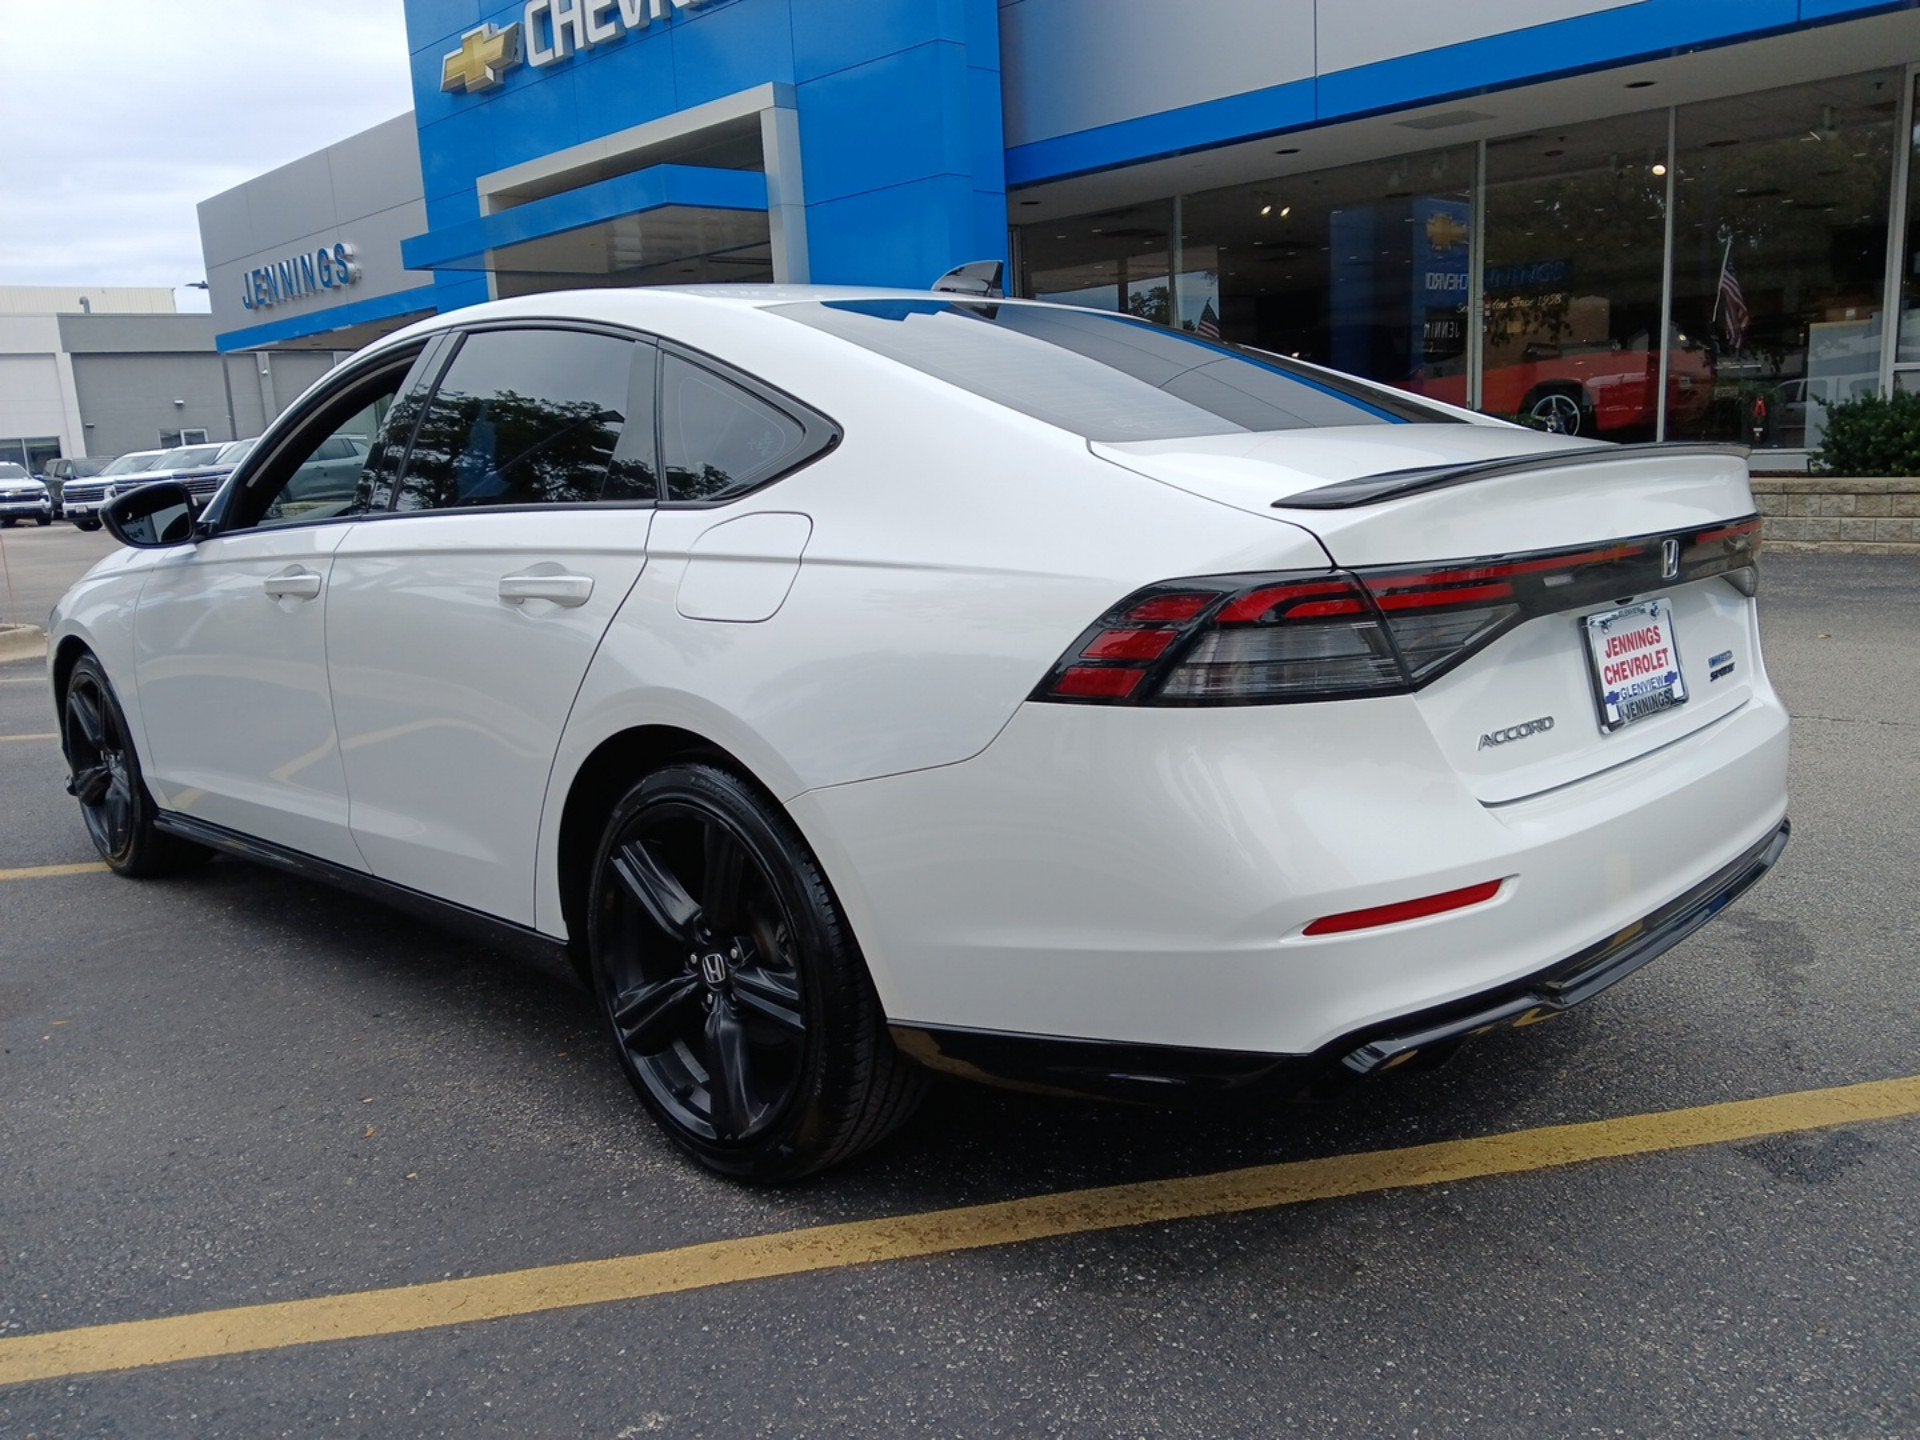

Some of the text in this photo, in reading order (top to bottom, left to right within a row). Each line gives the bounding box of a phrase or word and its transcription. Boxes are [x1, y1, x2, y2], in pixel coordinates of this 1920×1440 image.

[242, 242, 355, 310] JENNINGS
[1605, 625, 1661, 659] JENNINGS
[1603, 648, 1669, 685] CHEVROLET
[1620, 676, 1665, 700] GLENVIEW
[1624, 688, 1671, 720] JENNINGS
[1478, 715, 1555, 751] ACCORD
